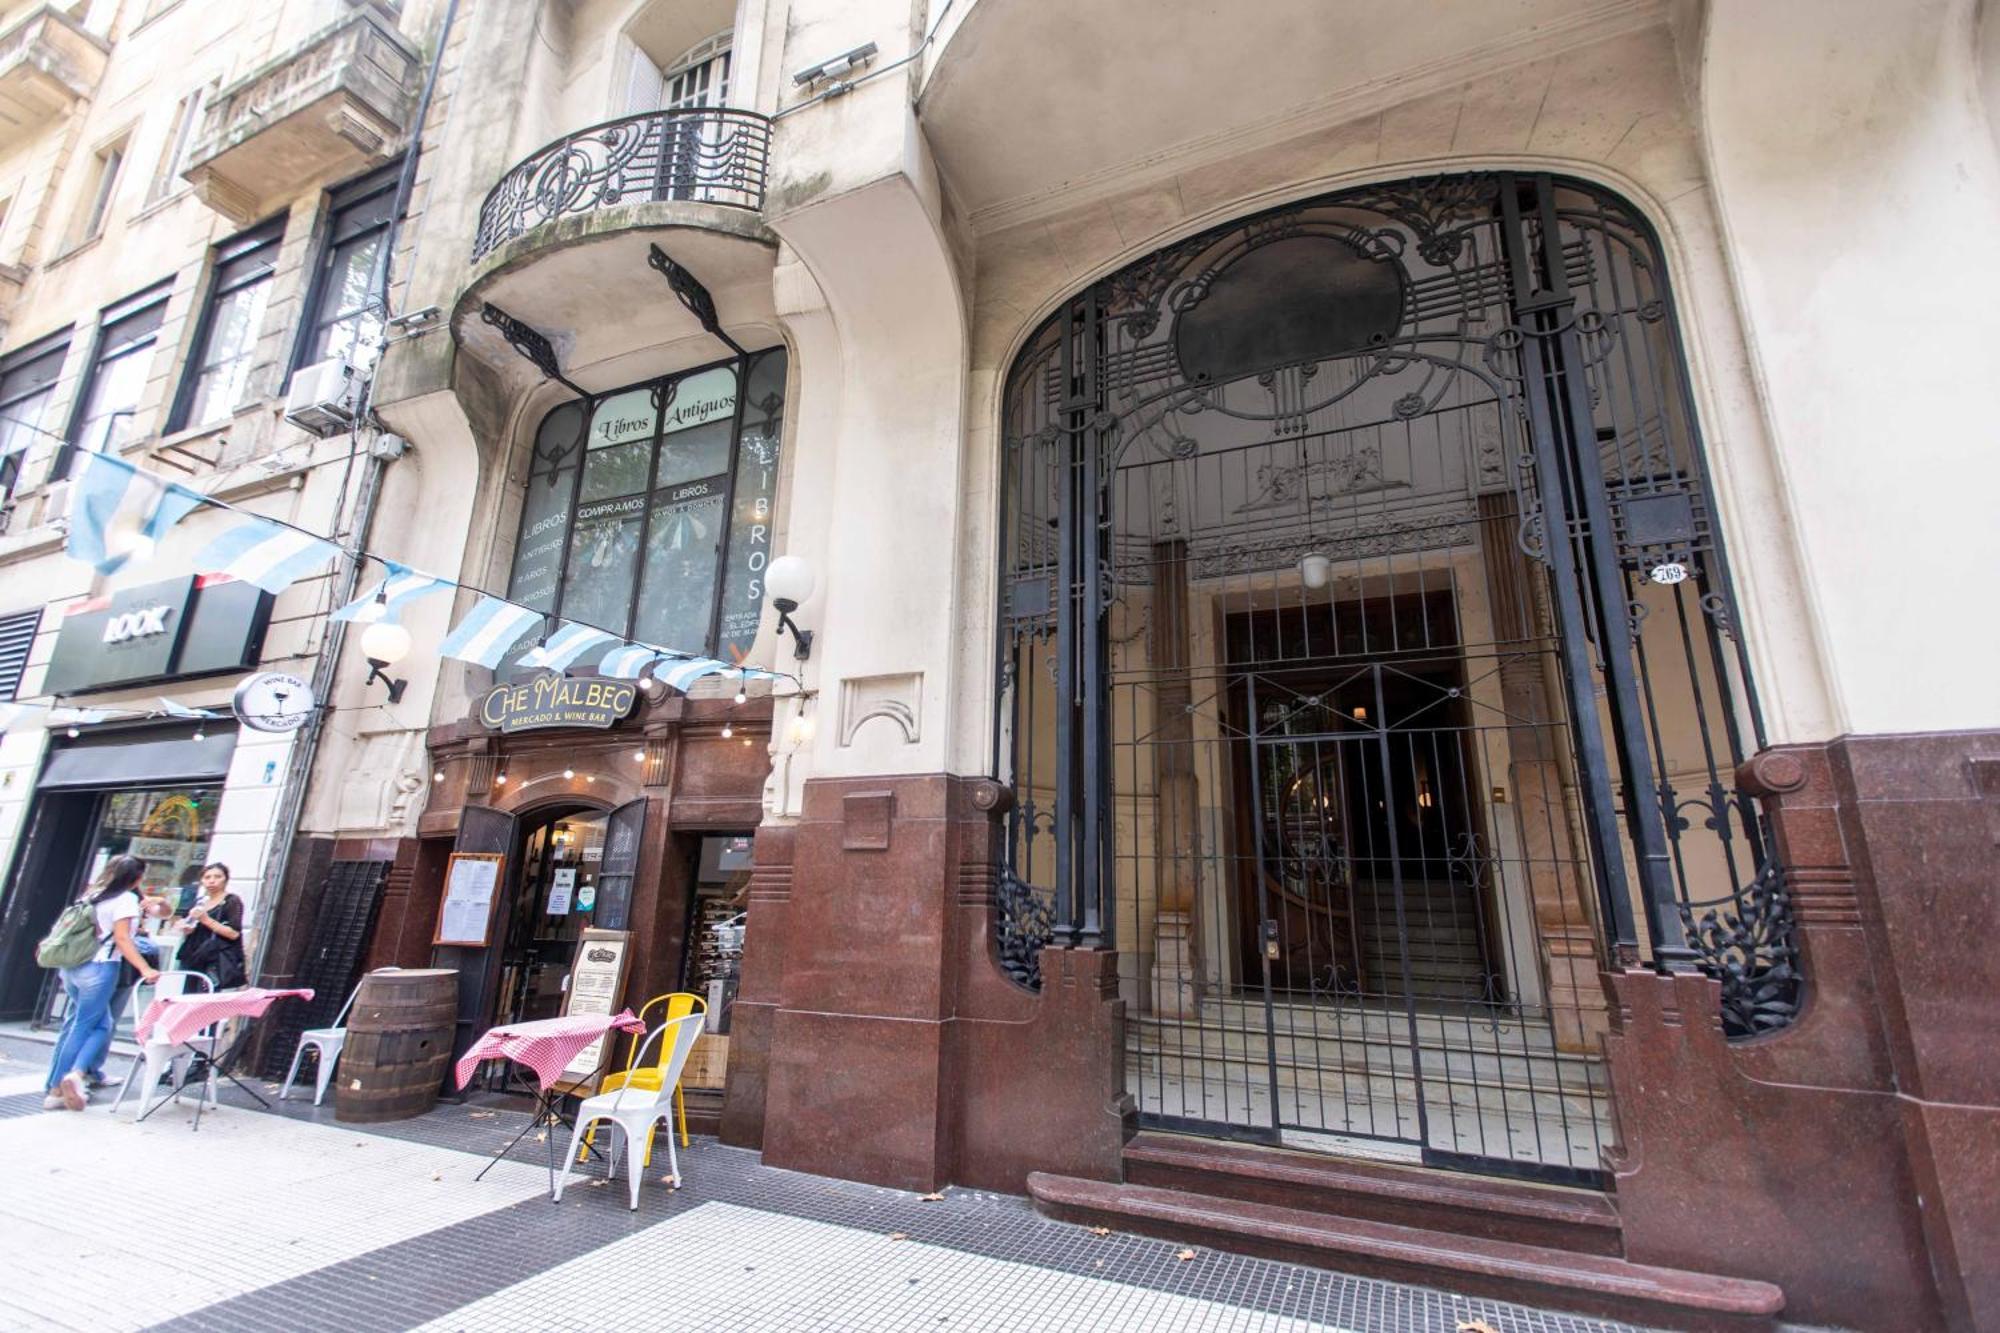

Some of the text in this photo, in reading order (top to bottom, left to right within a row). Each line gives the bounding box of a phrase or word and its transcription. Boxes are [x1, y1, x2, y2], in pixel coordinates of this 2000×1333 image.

[599, 395, 736, 441] Libros Antiguos
[578, 484, 709, 519] COMPRAMOS LIBROS
[523, 511, 568, 540] LIBROS
[748, 445, 771, 600] LIBROS
[521, 537, 564, 561] ANTIGUOS
[516, 566, 549, 584] RAROS
[1658, 566, 1681, 580] 769
[485, 677, 631, 722] CHE MALBEC
[511, 711, 606, 726] MERCADO & WINE BAR
